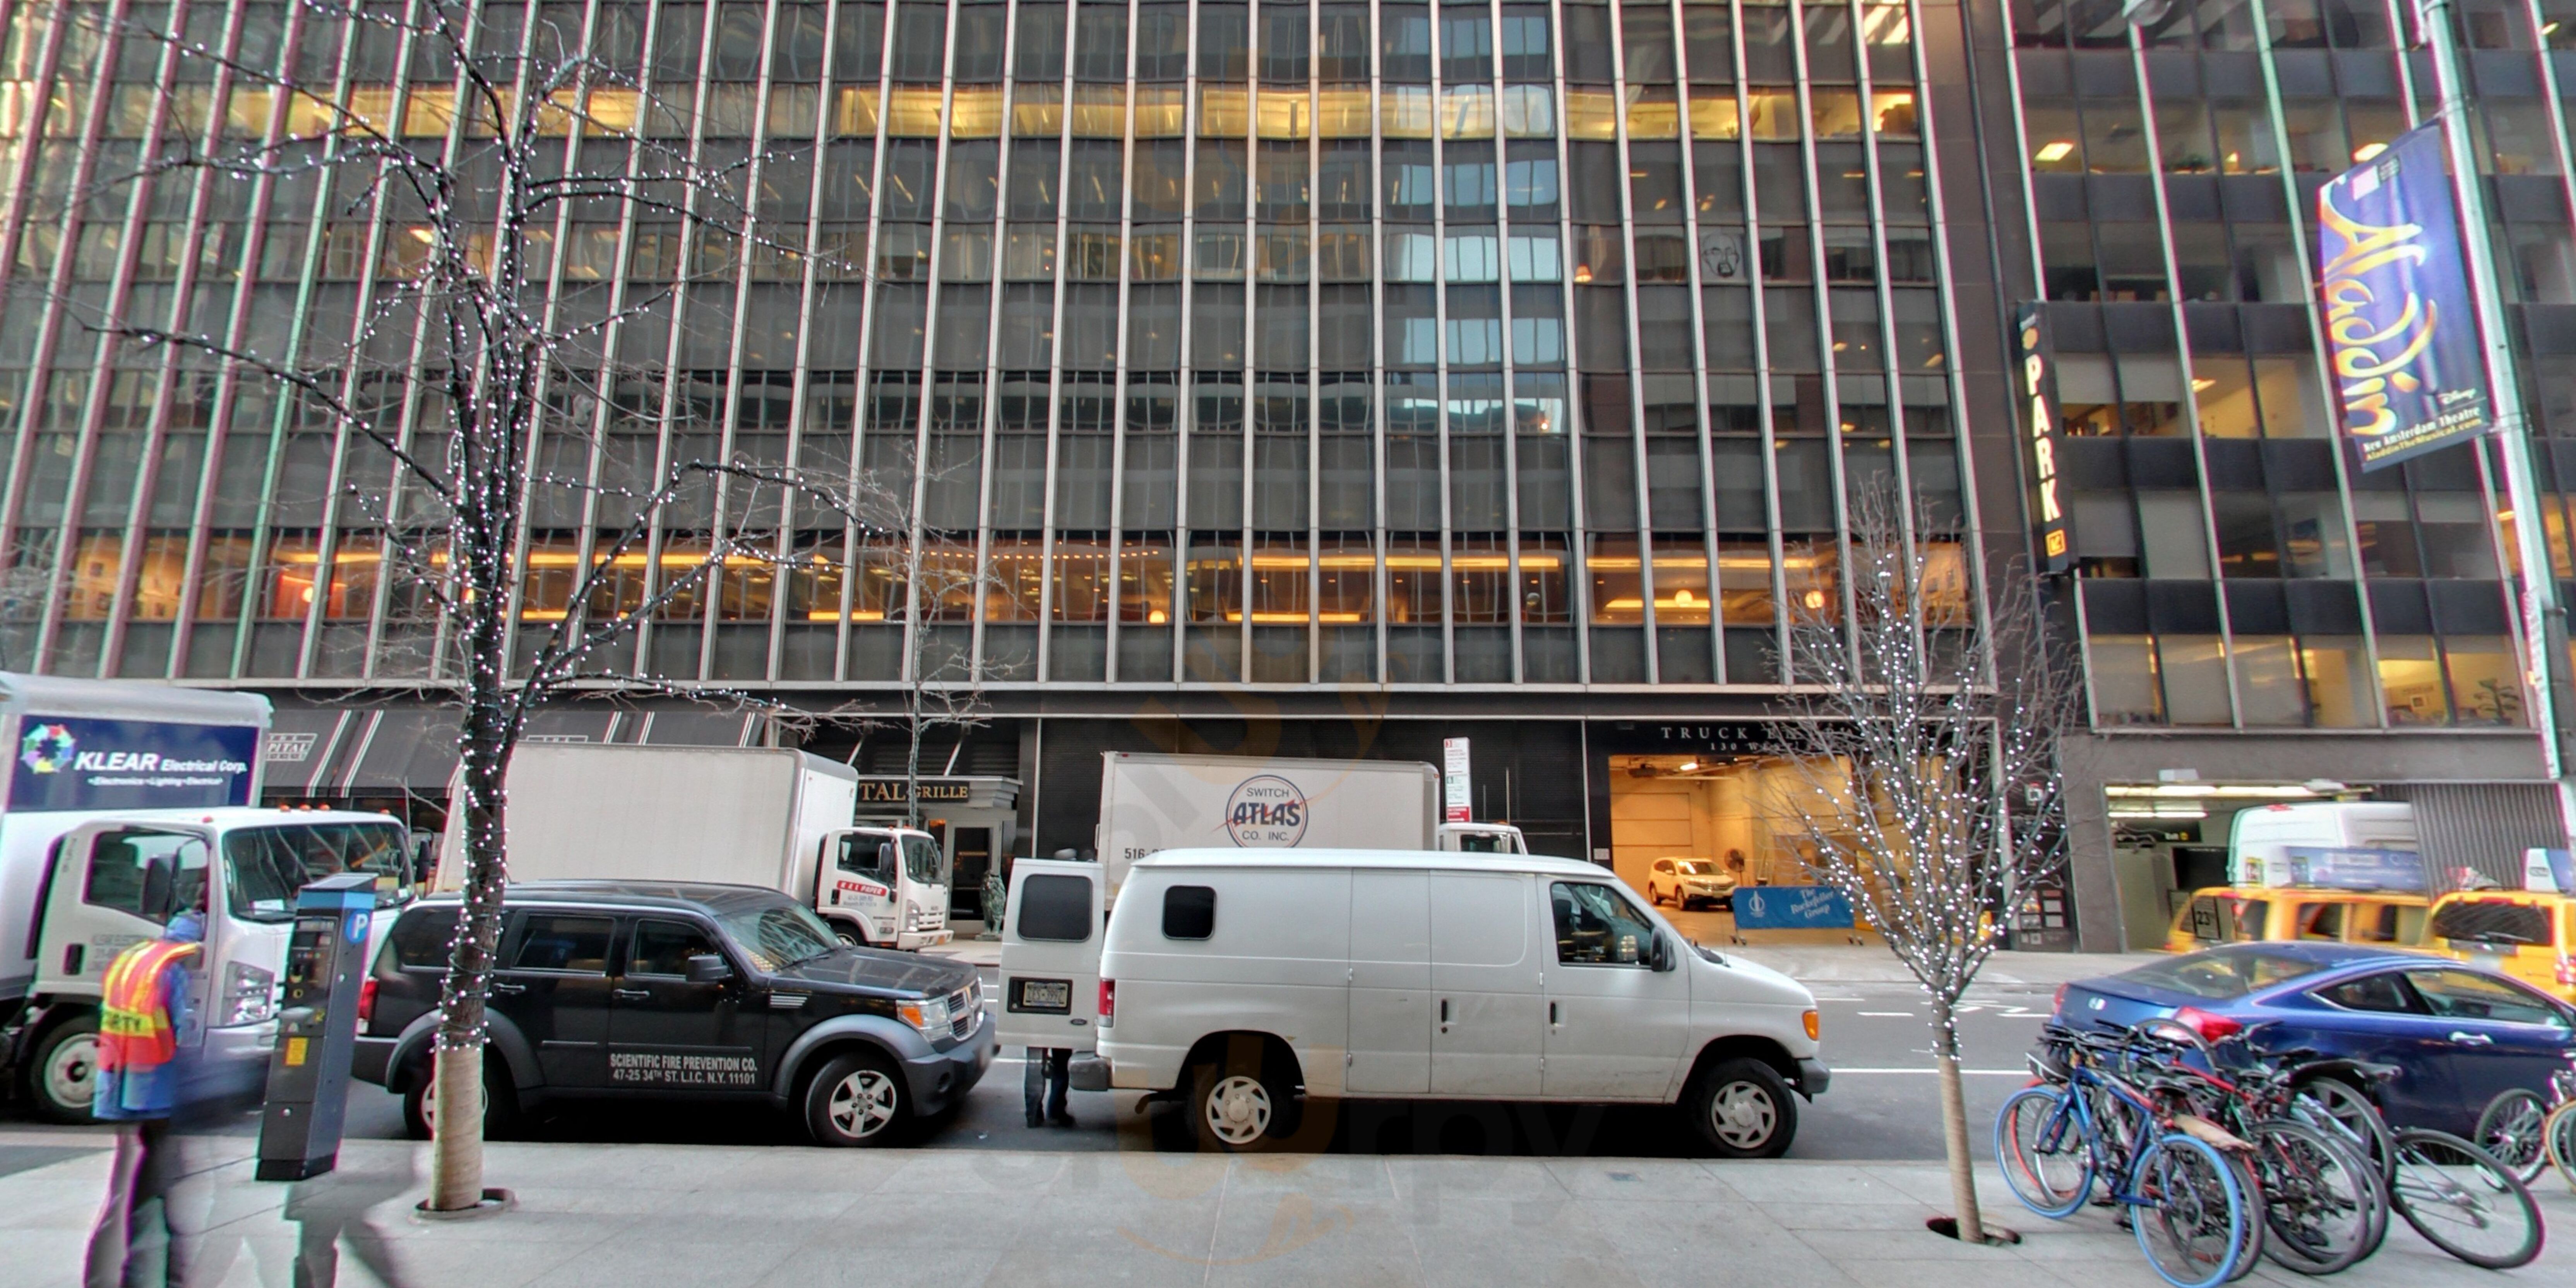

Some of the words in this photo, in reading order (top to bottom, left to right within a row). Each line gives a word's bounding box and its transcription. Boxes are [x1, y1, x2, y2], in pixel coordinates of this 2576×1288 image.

[2318, 174, 2437, 436] Aladdin
[2438, 388, 2477, 404] Disney
[2025, 354, 2062, 522] PARK
[2363, 440, 2382, 452] New
[2384, 421, 2437, 445] Amsterdam
[2439, 407, 2480, 426] Theatre
[1661, 727, 1748, 739] TRUCK
[1710, 742, 1737, 751] 130
[73, 751, 159, 771] KLEAR
[160, 758, 216, 772] Electrical
[219, 760, 247, 774] Corp.
[915, 786, 968, 798] GRILLE
[1247, 788, 1290, 798] SWITCH
[1233, 802, 1301, 827] ATLAS
[1242, 831, 1261, 841] CO.
[1268, 831, 1290, 841] INC.
[353, 914, 368, 939] P
[610, 1053, 660, 1068] SCIENTIFIC
[662, 1055, 682, 1069] FIRE
[683, 1056, 740, 1071] PREVENTION
[741, 1057, 758, 1072] CO.
[613, 1069, 641, 1081] 47-25
[665, 1070, 679, 1082] ST.
[681, 1071, 705, 1083] L.I.C.
[707, 1072, 726, 1083] N.Y.
[728, 1072, 755, 1084] 11101
